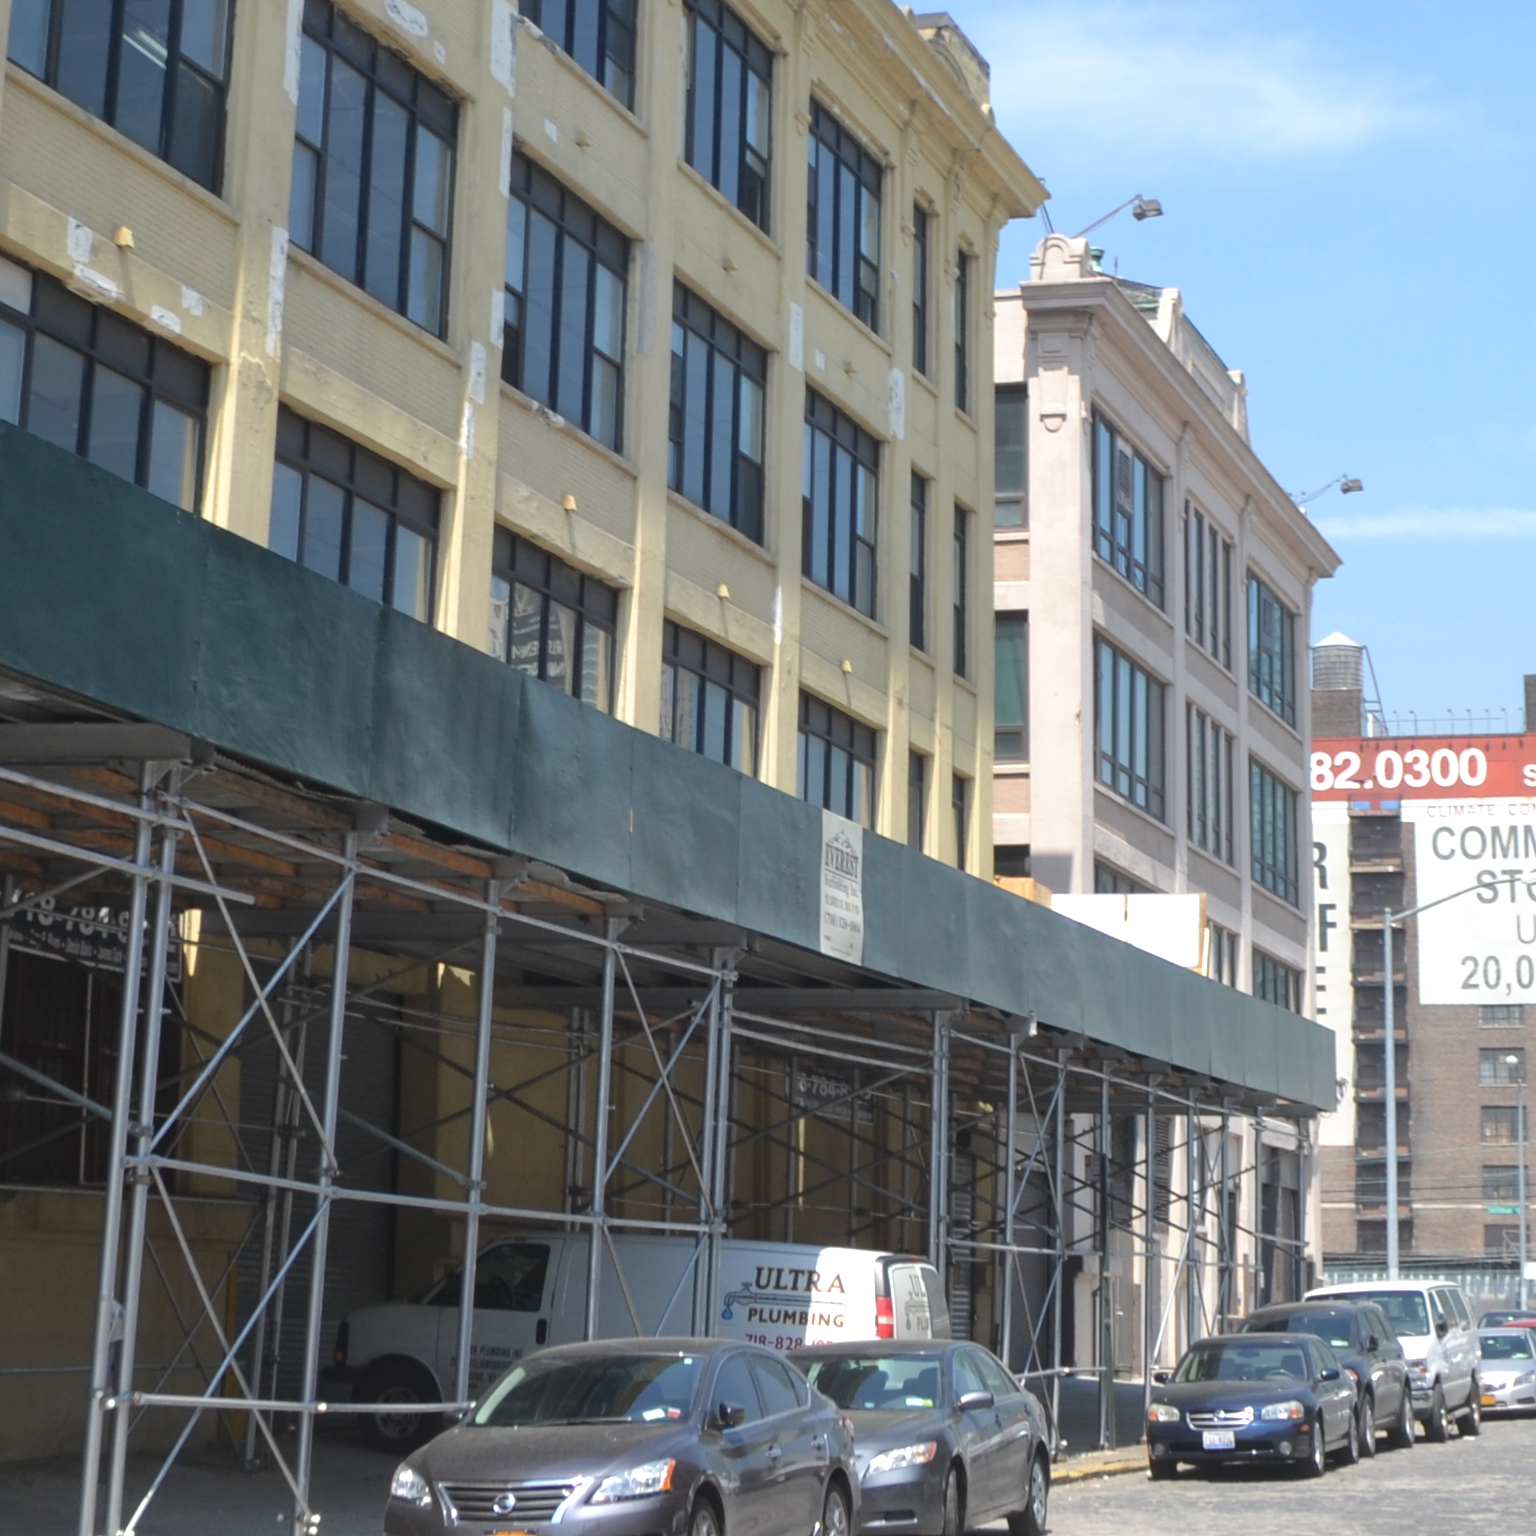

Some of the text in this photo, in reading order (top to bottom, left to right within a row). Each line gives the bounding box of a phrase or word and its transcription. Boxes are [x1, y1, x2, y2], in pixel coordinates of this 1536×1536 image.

[1426, 804, 1496, 818] CLIMATE
[824, 842, 859, 880] EVEREST
[753, 1266, 847, 1295] ULTRA
[747, 1306, 845, 1329] PLUMBING
